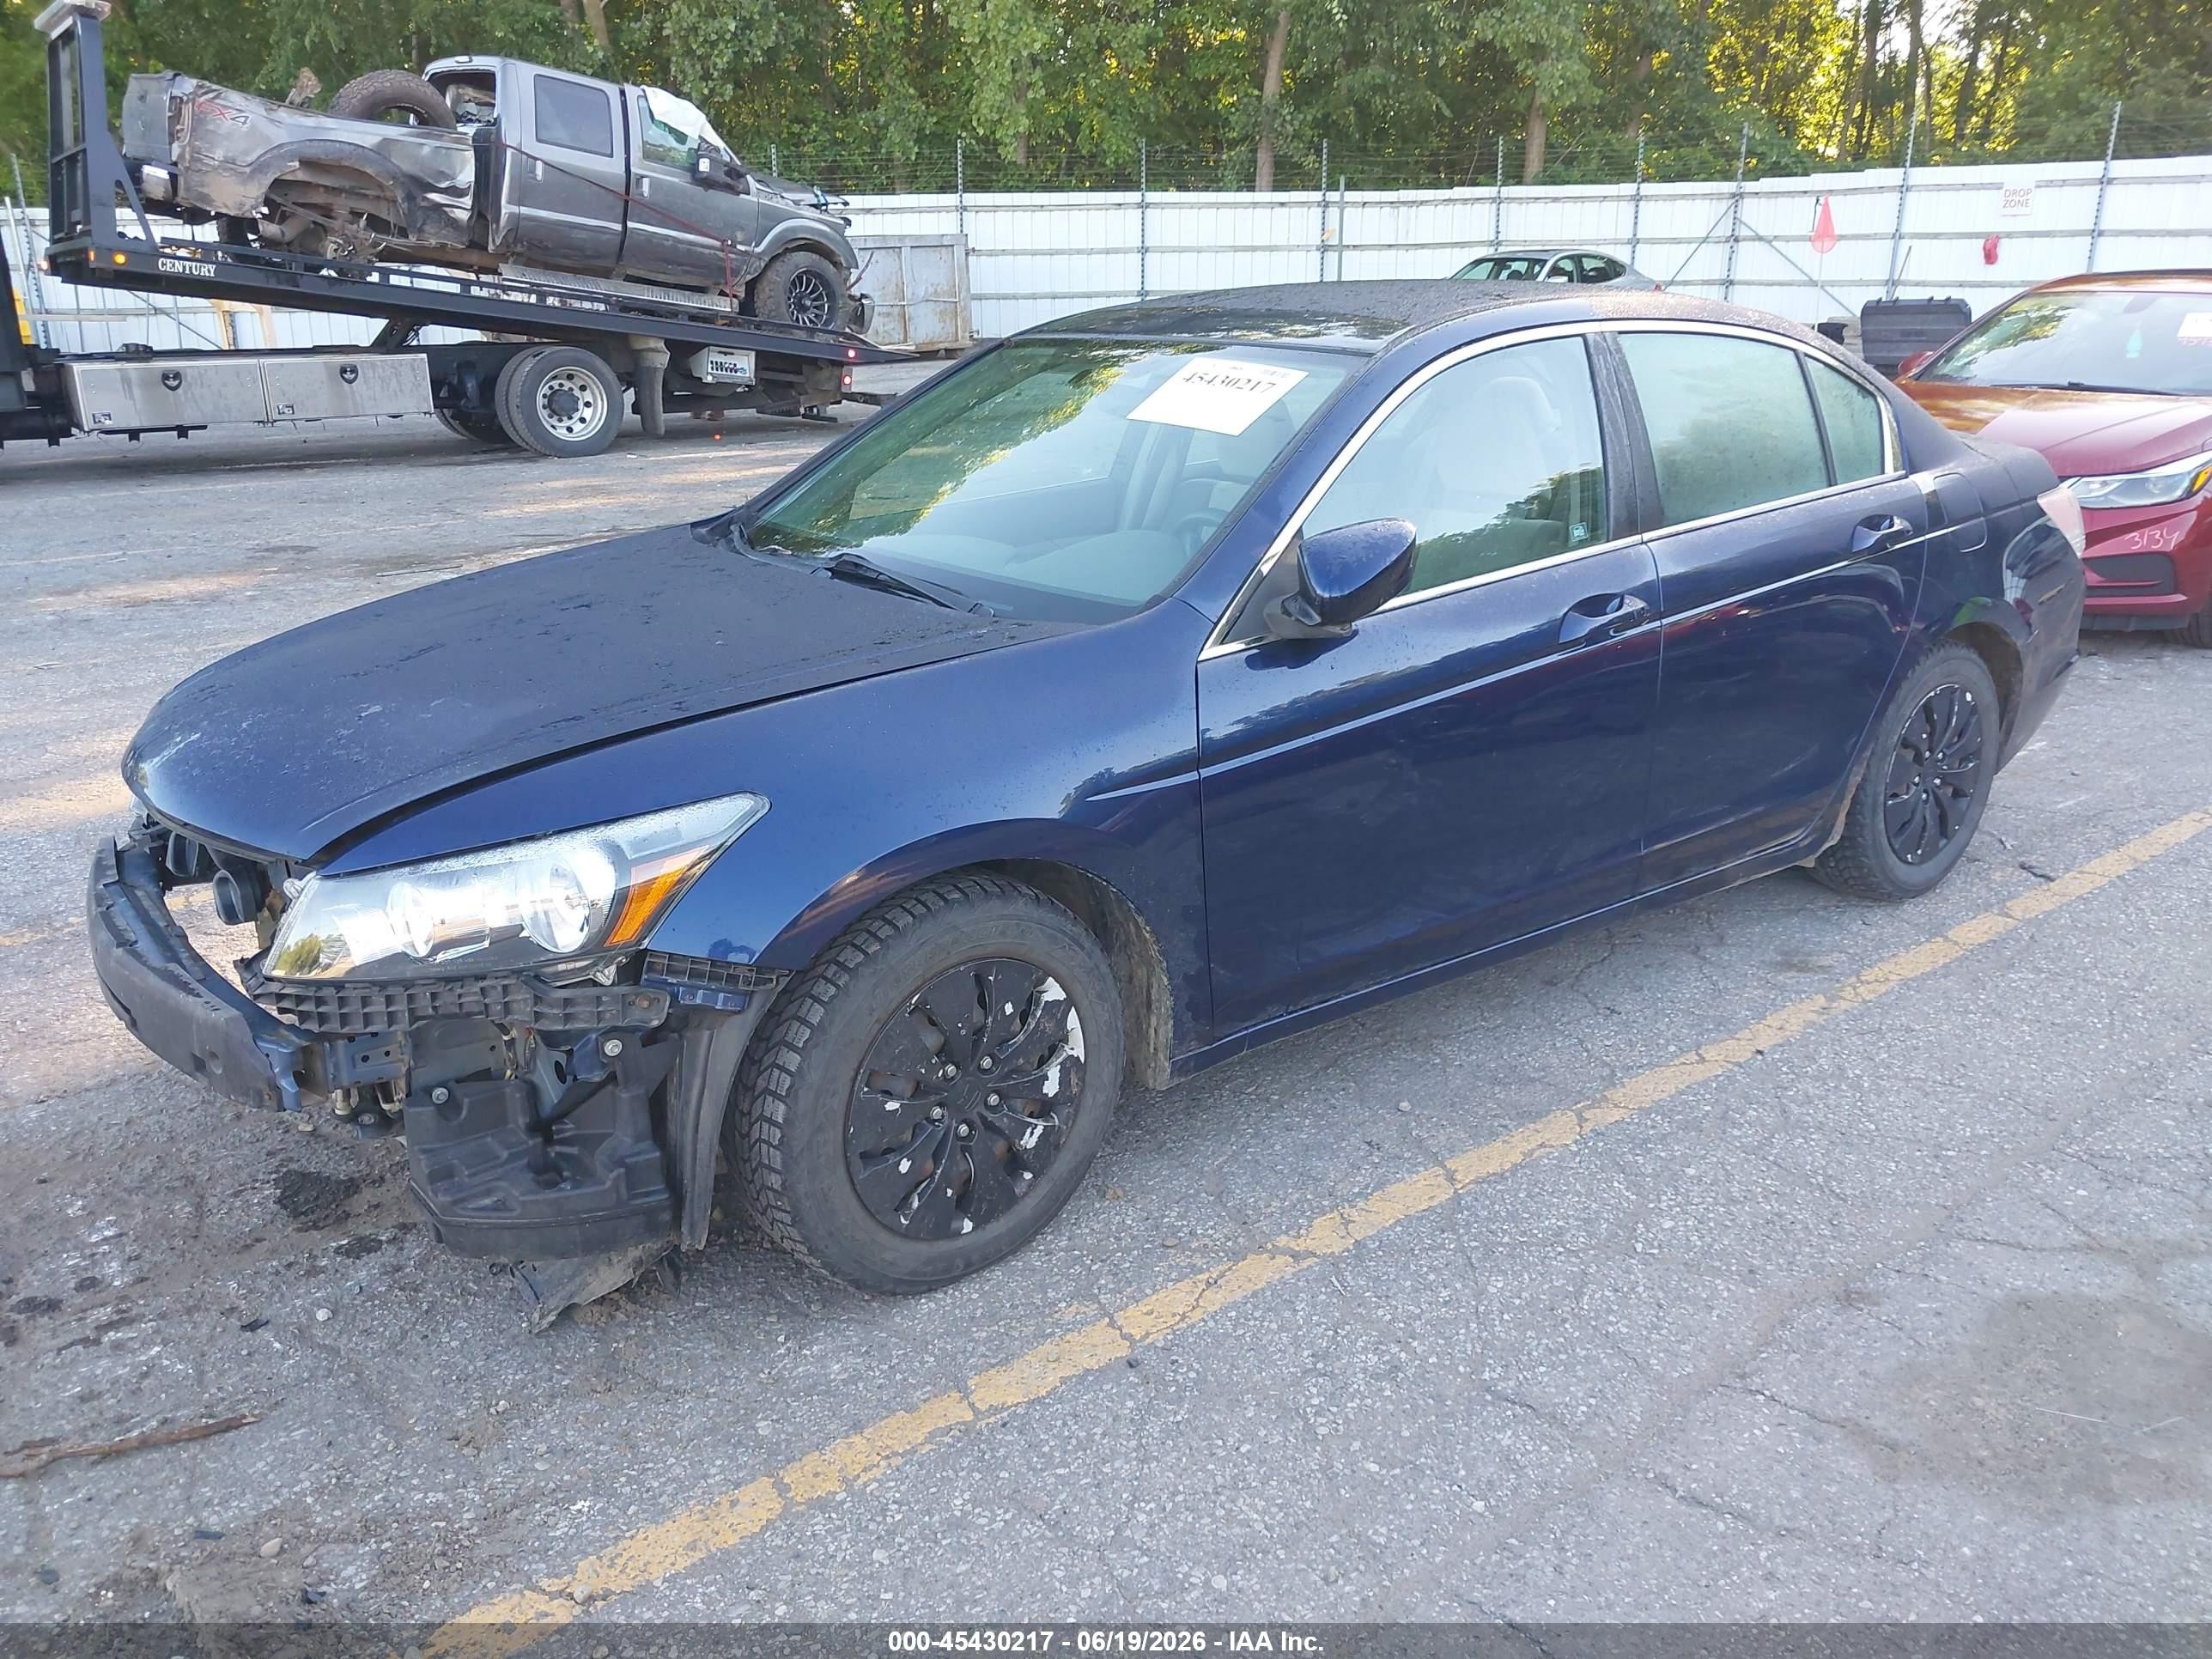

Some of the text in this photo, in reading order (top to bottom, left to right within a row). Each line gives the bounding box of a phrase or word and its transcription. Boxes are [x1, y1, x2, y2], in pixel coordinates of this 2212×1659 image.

[2004, 188, 2033, 198] DROP
[2002, 198, 2031, 209] ZONE
[158, 258, 216, 277] CENTURY
[1182, 372, 1277, 393] 45430217
[2124, 527, 2180, 550] 3134
